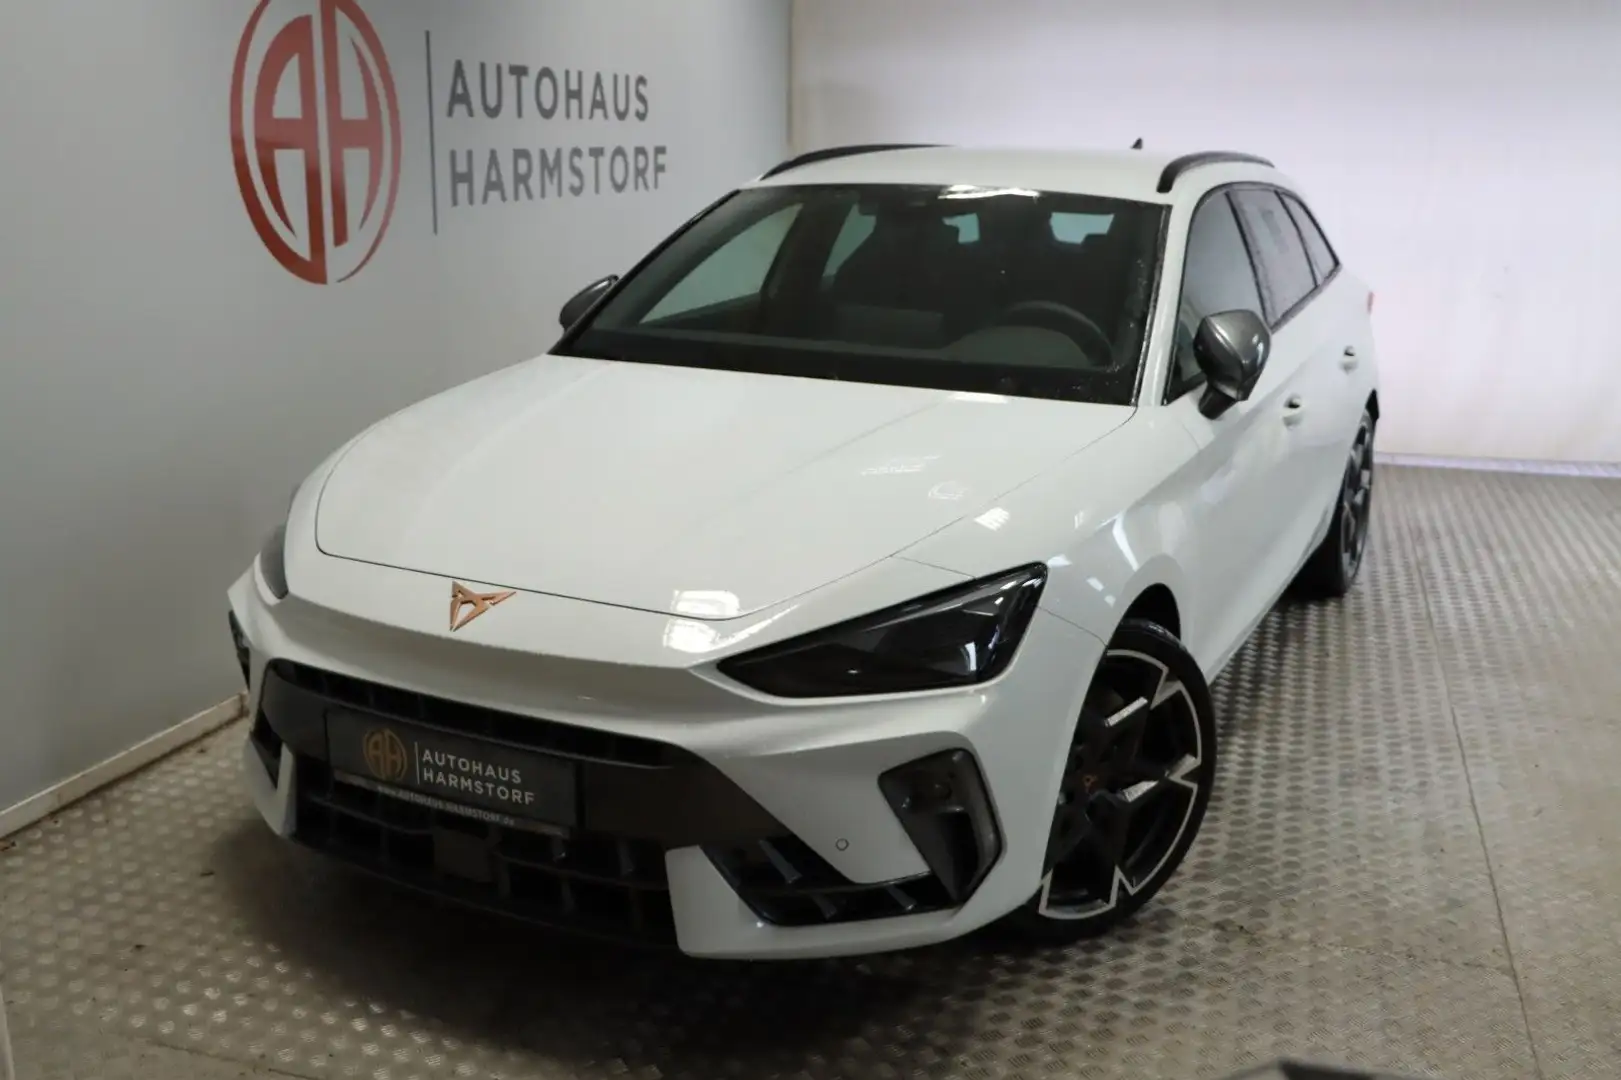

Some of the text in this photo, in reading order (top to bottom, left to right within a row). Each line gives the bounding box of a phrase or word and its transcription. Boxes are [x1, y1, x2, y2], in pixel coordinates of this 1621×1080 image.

[447, 59, 649, 121] AUTOHAUS
[450, 146, 667, 207] HARMSTORF
[422, 749, 522, 784] AUTOHAUS
[423, 768, 535, 805] HARMSTORF
